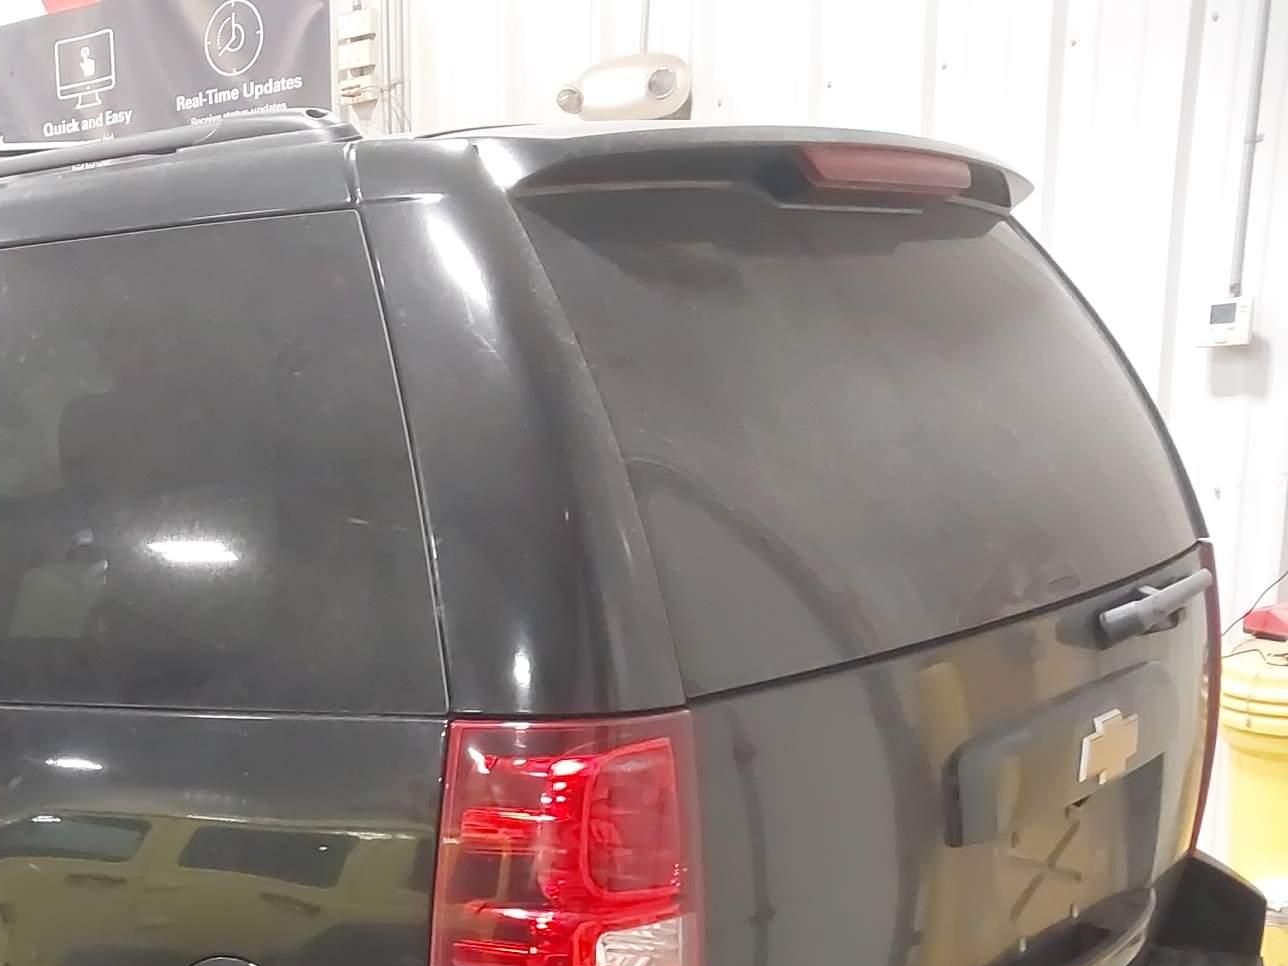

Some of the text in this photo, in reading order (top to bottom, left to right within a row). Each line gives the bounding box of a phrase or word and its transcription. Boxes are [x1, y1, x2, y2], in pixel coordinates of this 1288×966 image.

[176, 76, 303, 112] Real-Time Updates
[43, 118, 80, 137] Quick
[81, 112, 103, 131] and
[104, 110, 132, 126] Easy
